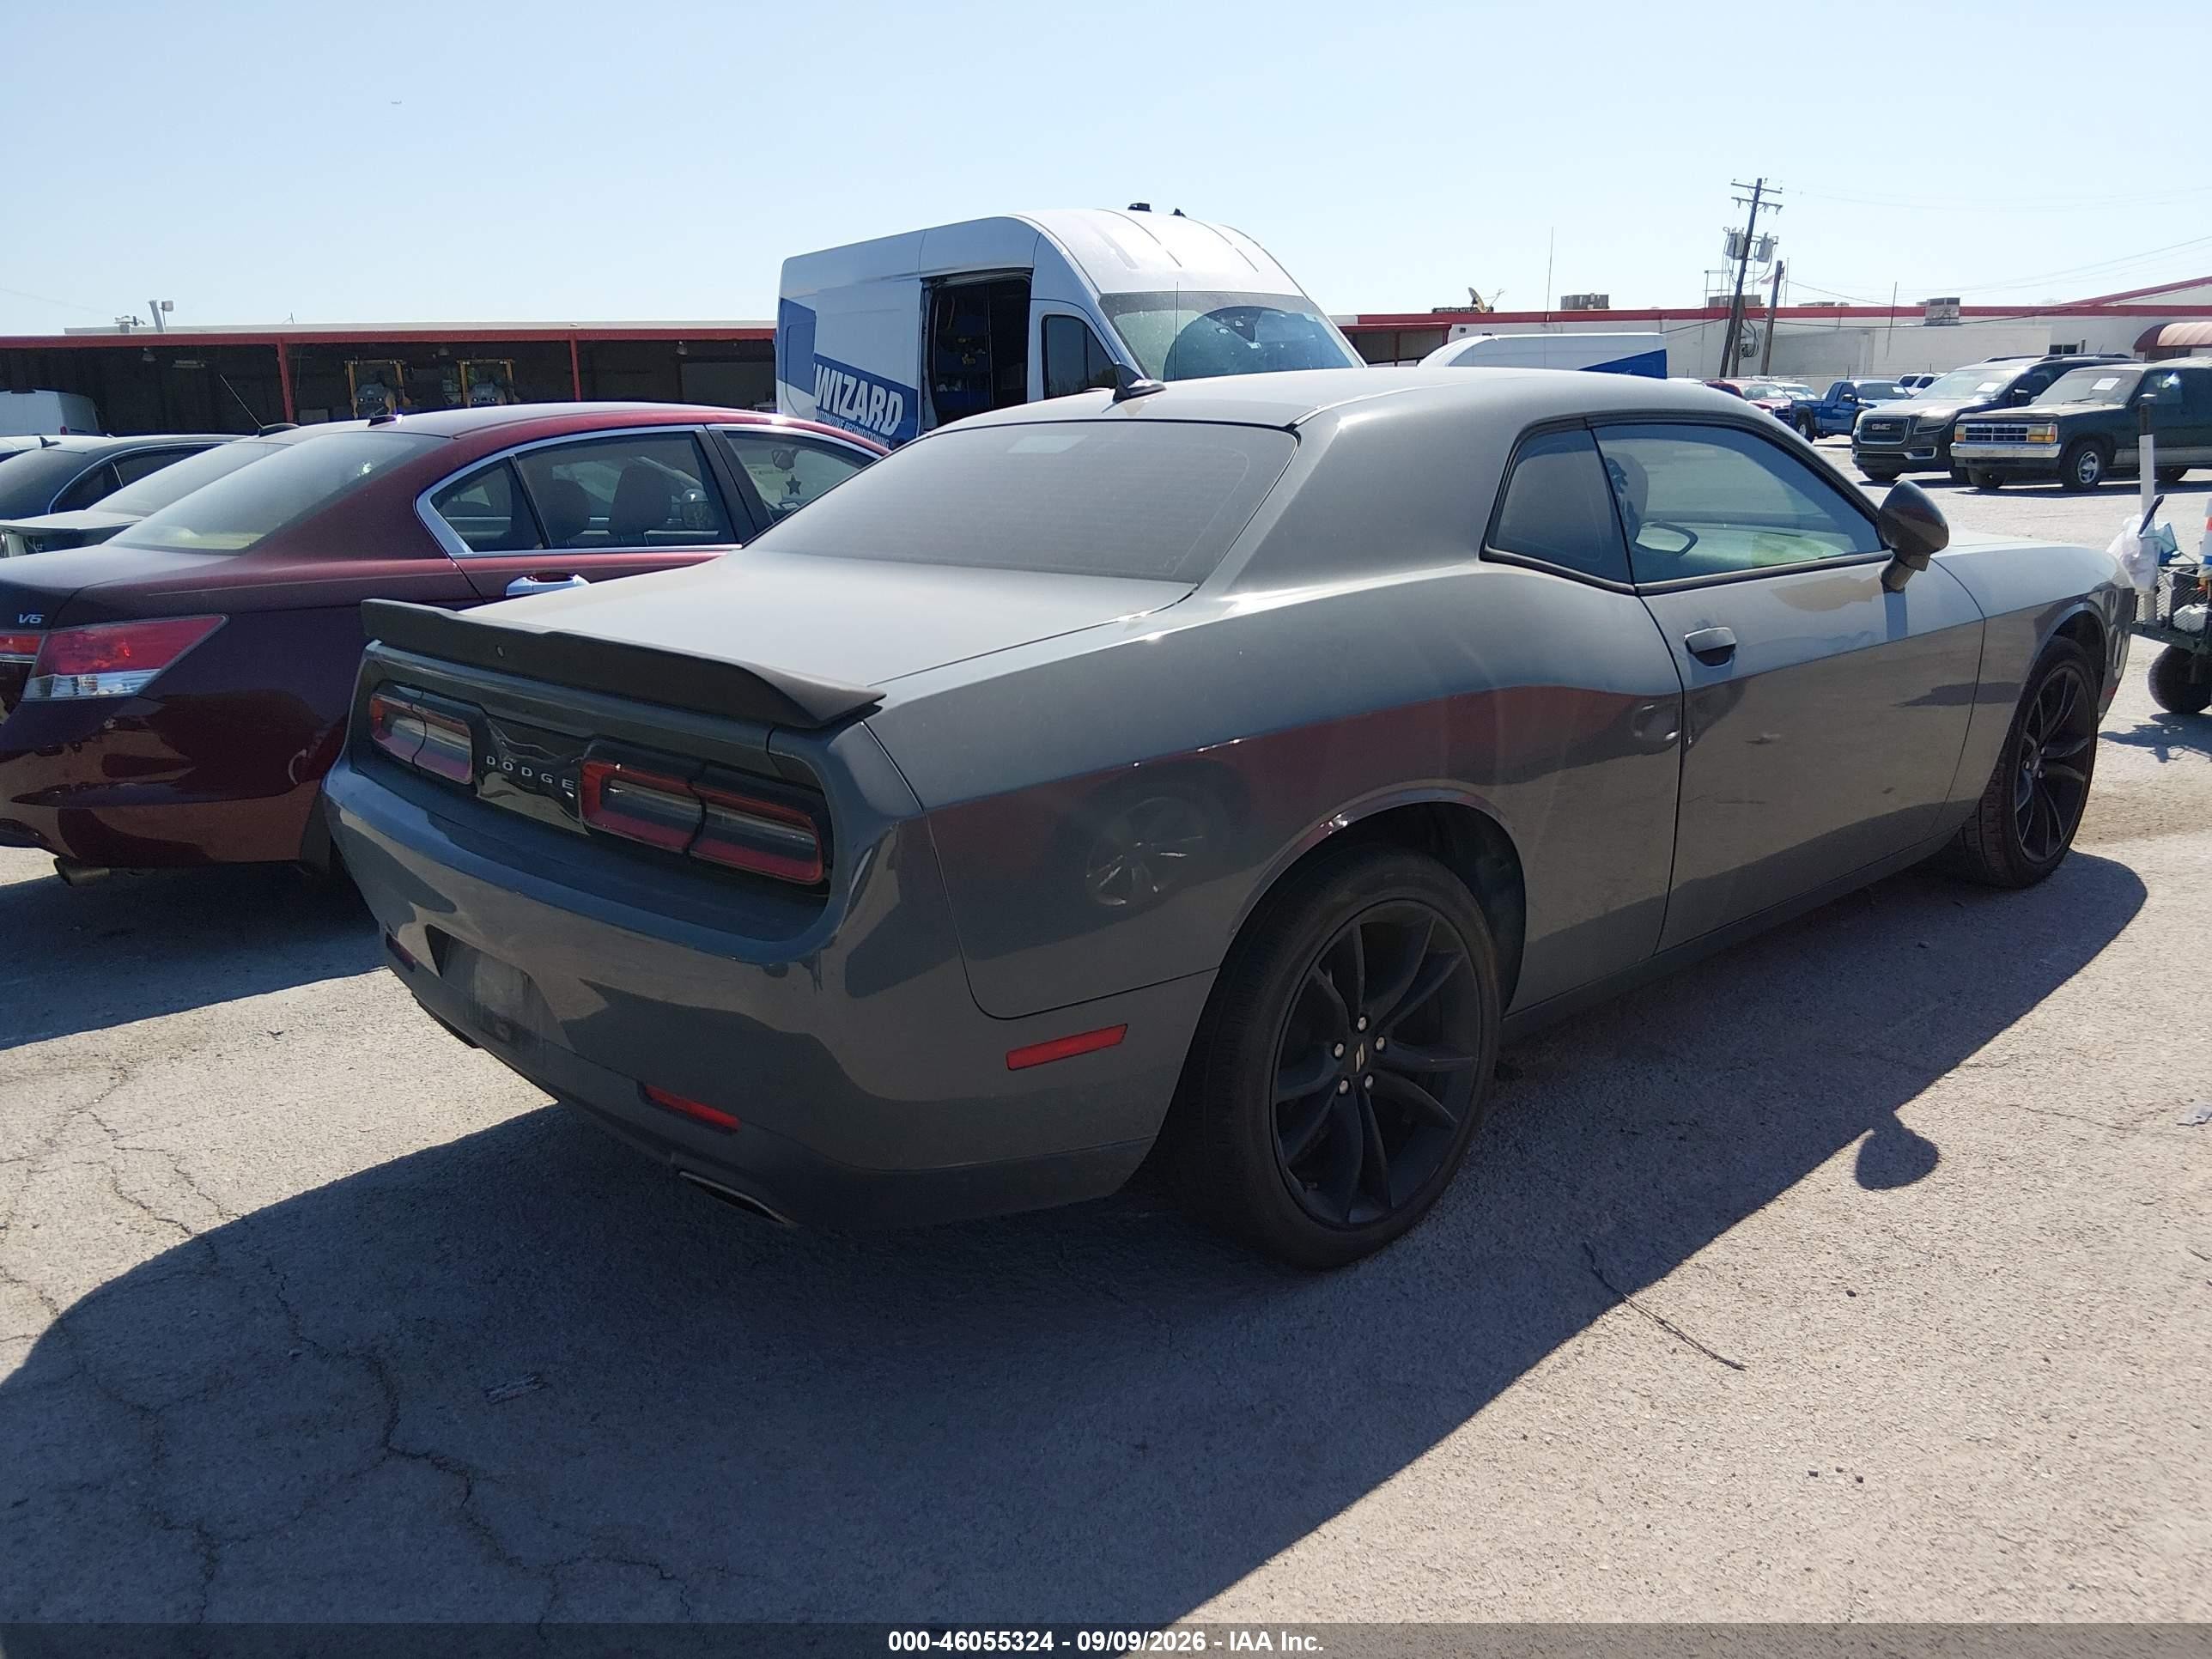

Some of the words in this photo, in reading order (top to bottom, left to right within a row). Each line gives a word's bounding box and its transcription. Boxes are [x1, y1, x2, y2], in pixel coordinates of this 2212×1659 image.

[815, 364, 903, 436] WIZARD
[19, 613, 45, 623] V6
[486, 756, 574, 790] DODGE
